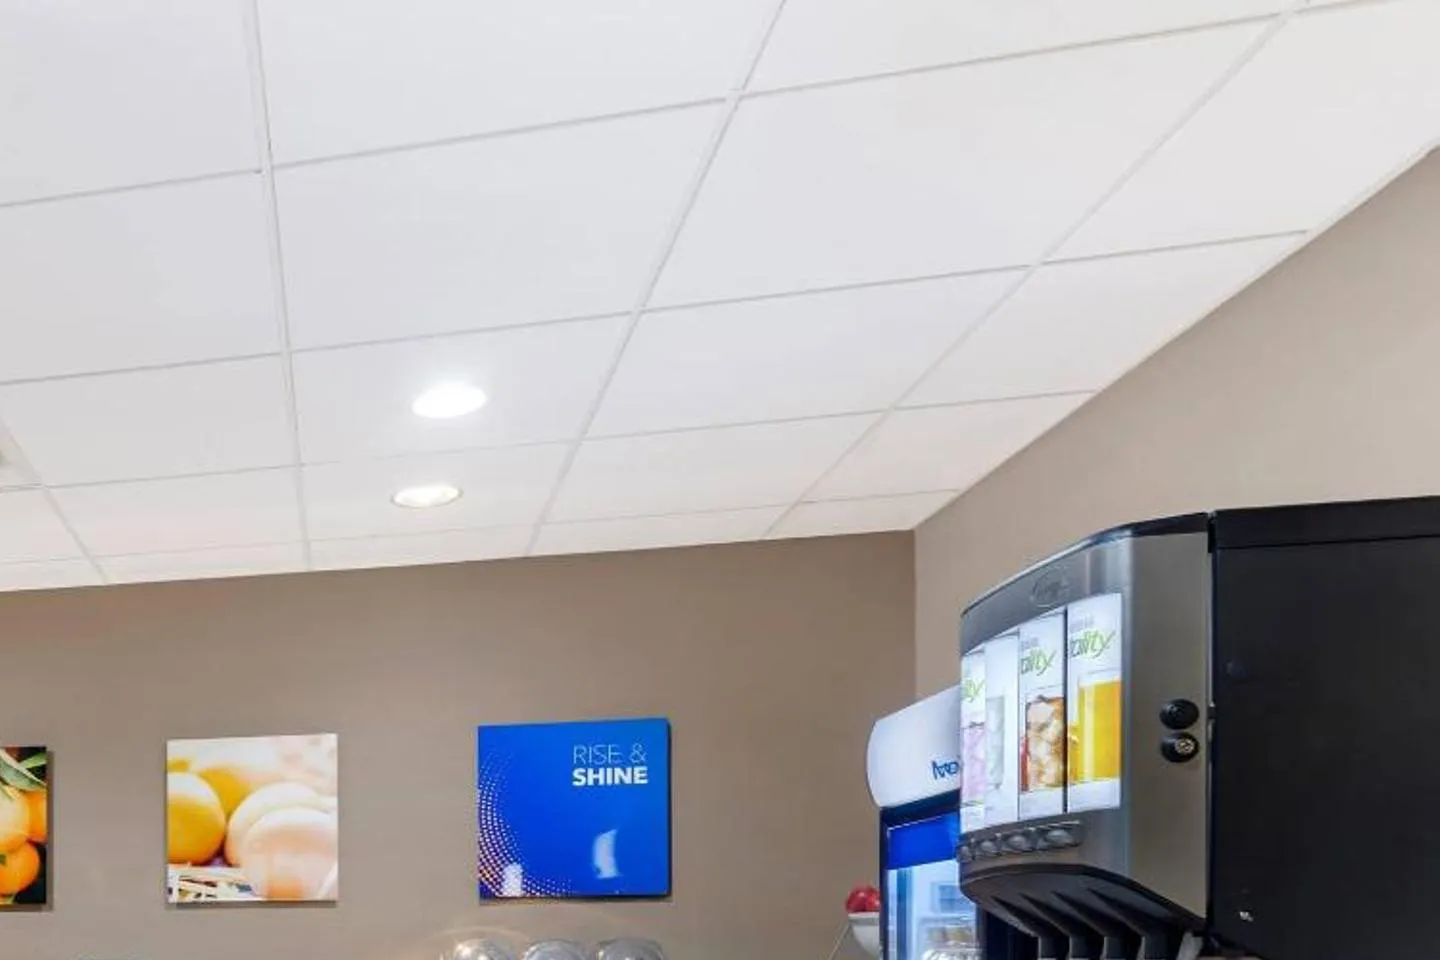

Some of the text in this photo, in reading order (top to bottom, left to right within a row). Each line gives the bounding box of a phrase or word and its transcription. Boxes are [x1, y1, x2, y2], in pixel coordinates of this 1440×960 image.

[573, 743, 647, 764] RISE &
[572, 766, 648, 787] SHINE
